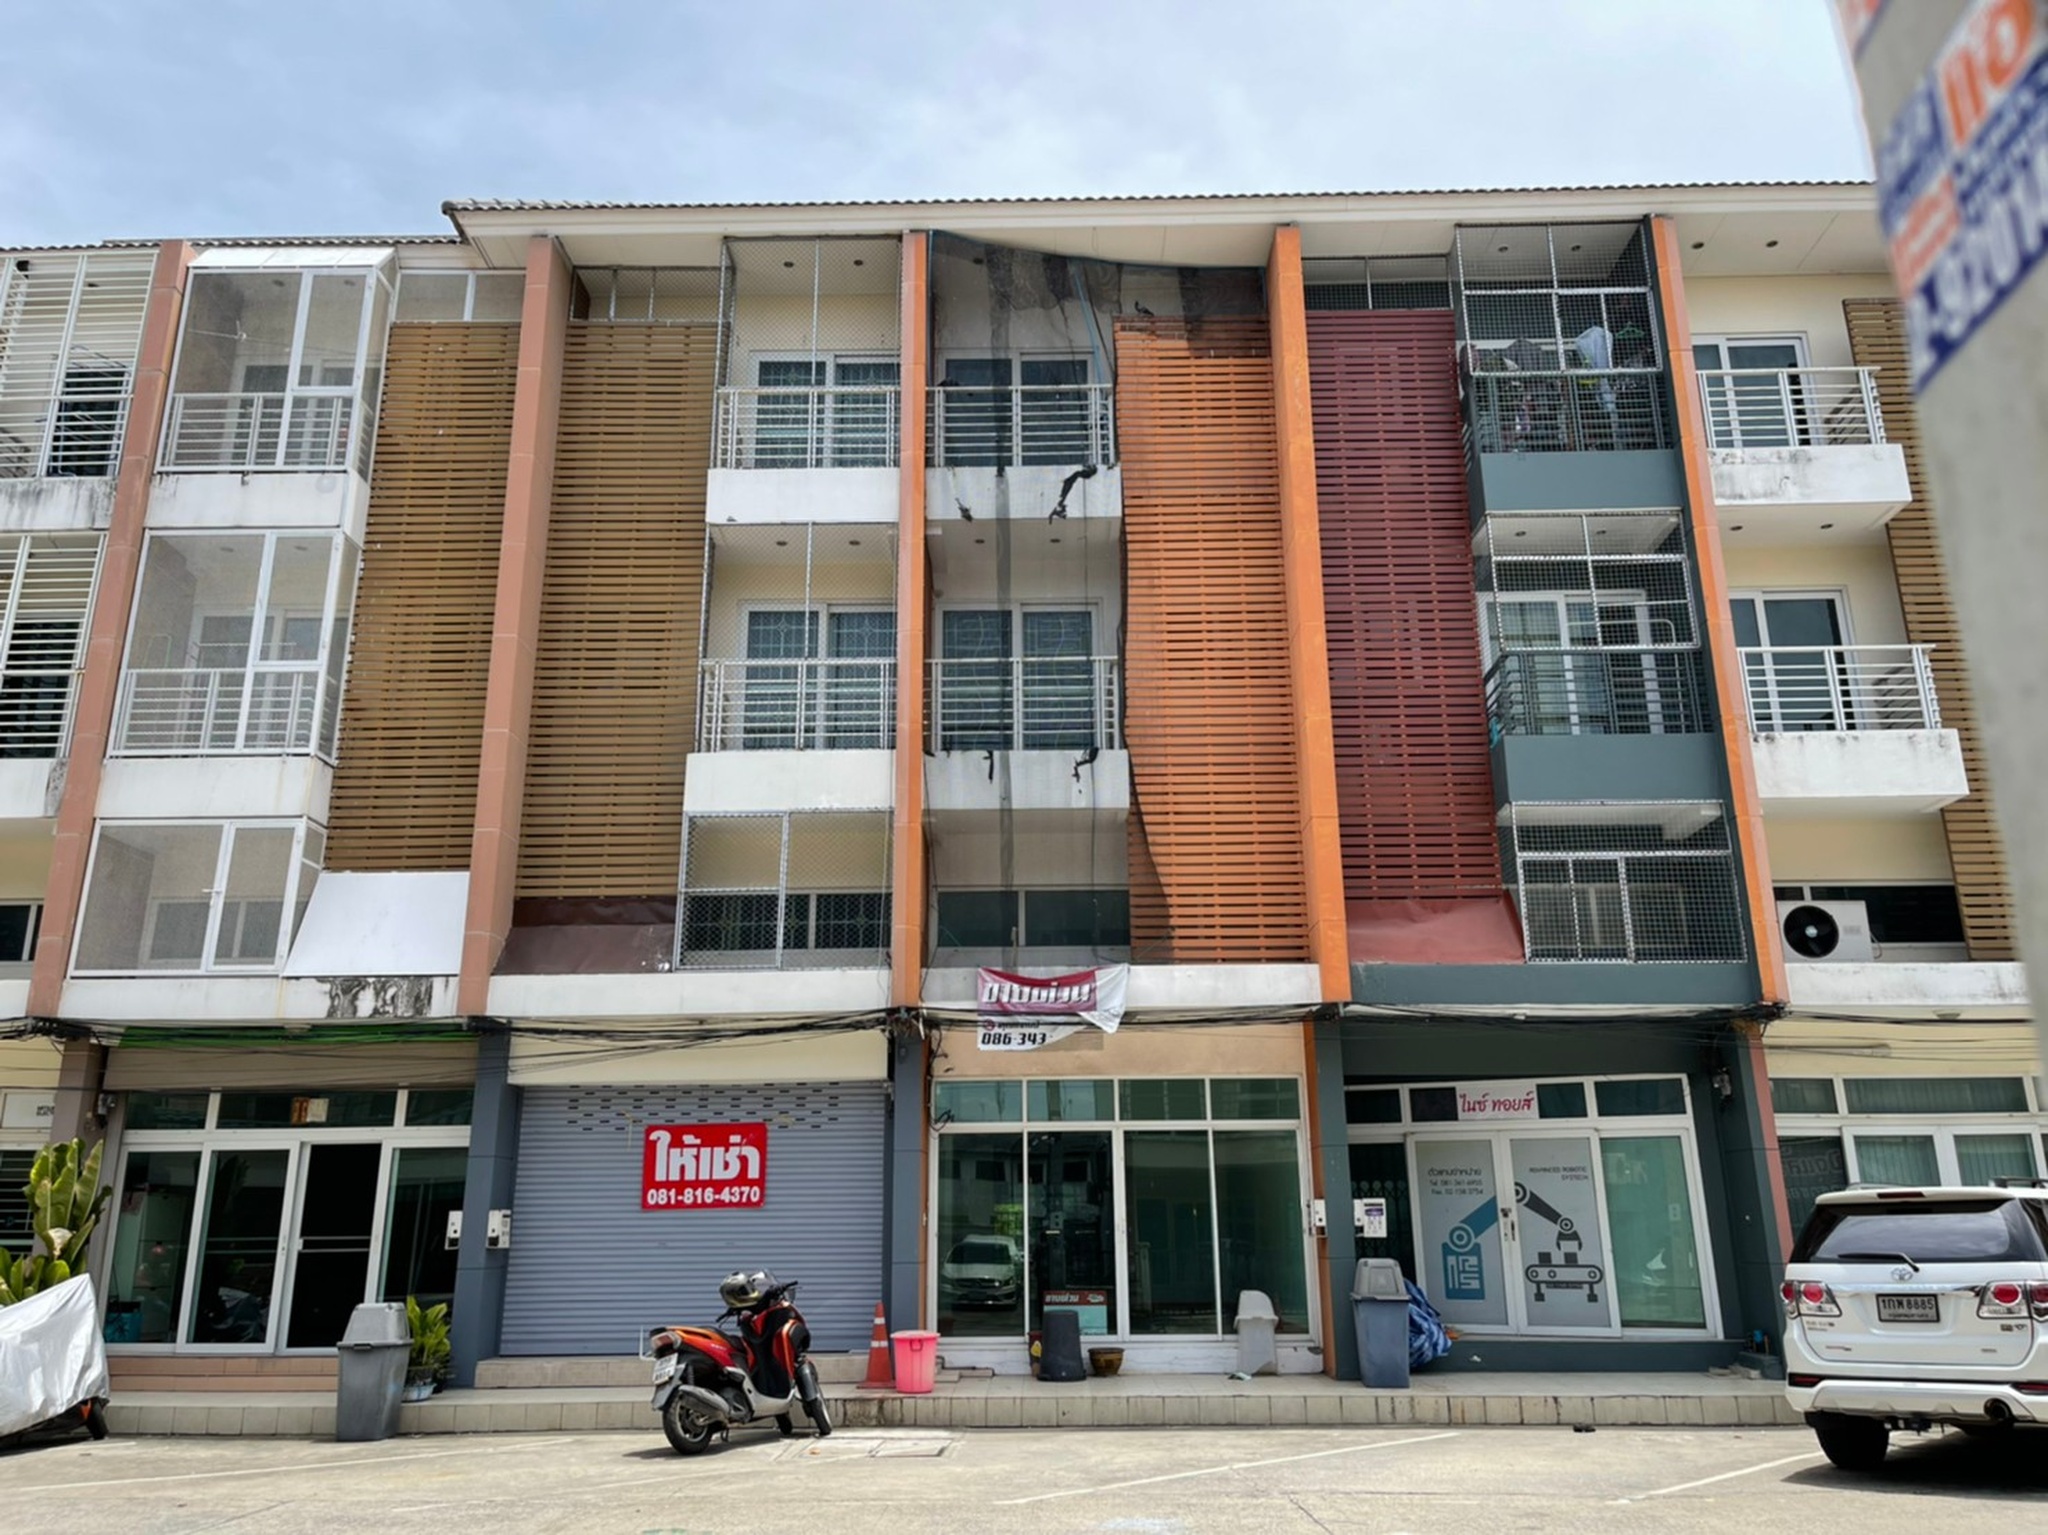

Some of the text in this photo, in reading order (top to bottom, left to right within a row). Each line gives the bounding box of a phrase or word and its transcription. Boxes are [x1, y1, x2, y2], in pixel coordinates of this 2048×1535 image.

[1459, 1090, 1535, 1113] ไนซ์ ทอยส์
[648, 1130, 761, 1182] ให้เช่า
[647, 1186, 761, 1205] 081-816-4370
